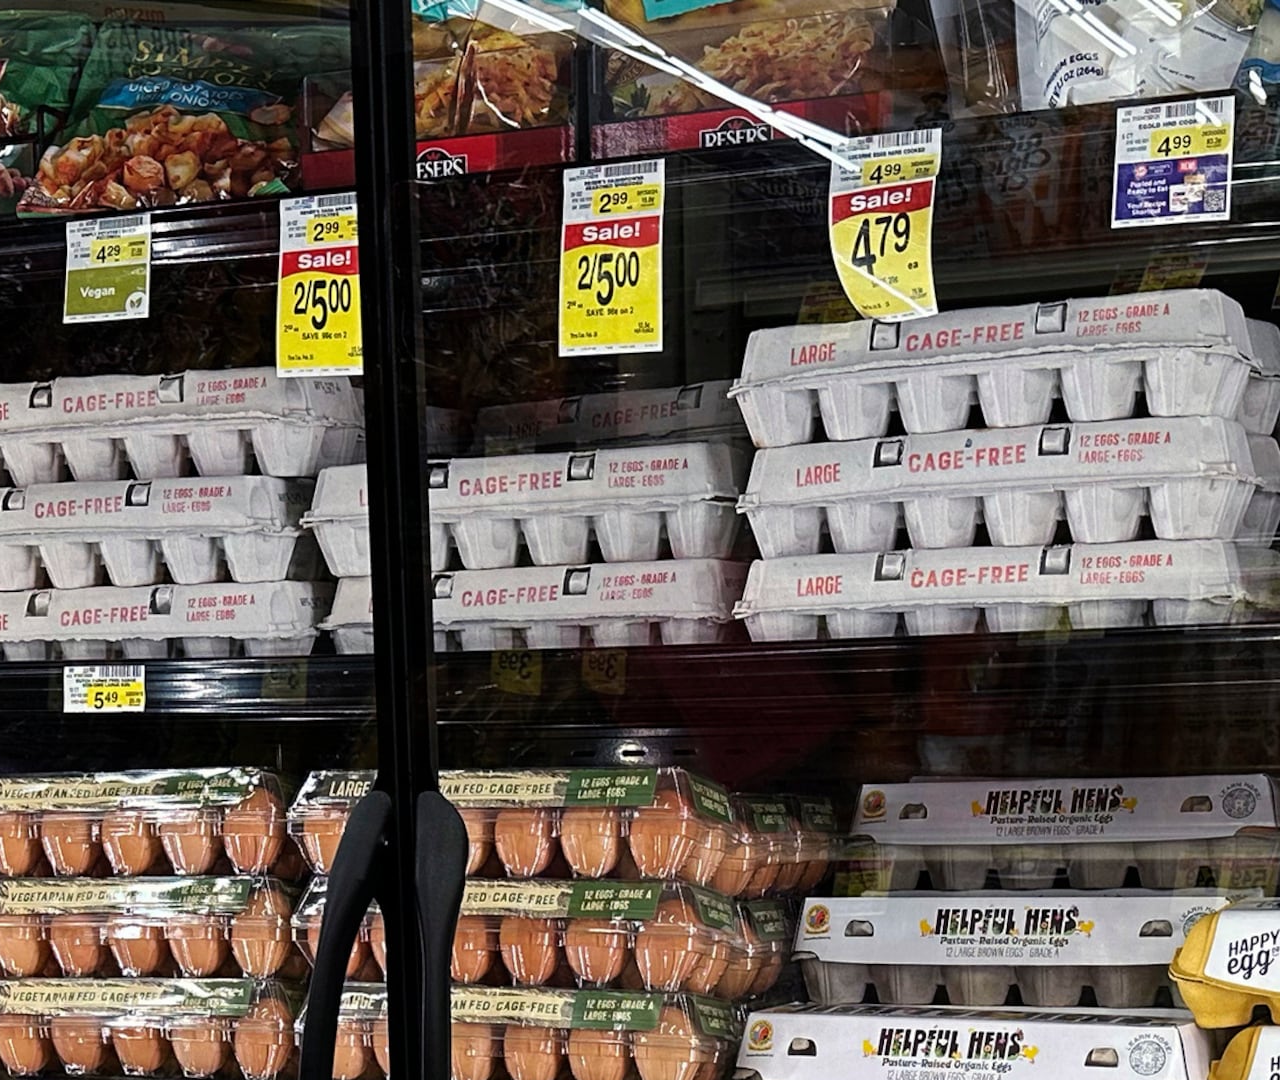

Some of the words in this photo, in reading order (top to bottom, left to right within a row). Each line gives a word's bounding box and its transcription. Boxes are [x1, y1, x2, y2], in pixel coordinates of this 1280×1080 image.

[850, 188, 912, 210] Sale!
[582, 222, 640, 242] Sale!
[906, 322, 1025, 353] CAGE-FREE
[790, 342, 836, 366] LARGE
[63, 391, 156, 413] CAGE-FREE
[1082, 558, 1093, 568] 12
[1096, 556, 1122, 568] EGGS
[1130, 554, 1162, 568] GRADE
[1166, 554, 1173, 566] A
[796, 576, 842, 596] LARGE
[911, 564, 1028, 588] CAGE-FREE
[469, 782, 486, 794] FED
[492, 782, 552, 795] CAGE-FREE
[11, 892, 73, 903] VEGETARIAN
[1229, 929, 1280, 957] HAPPY
[1227, 947, 1274, 979] egg
[878, 1028, 959, 1058] HELPFUL
[968, 1028, 1024, 1059] HENS
[882, 1058, 952, 1069] Pasture-Raised
[955, 1059, 989, 1072] Organic
[991, 1060, 1012, 1073] Eggs
